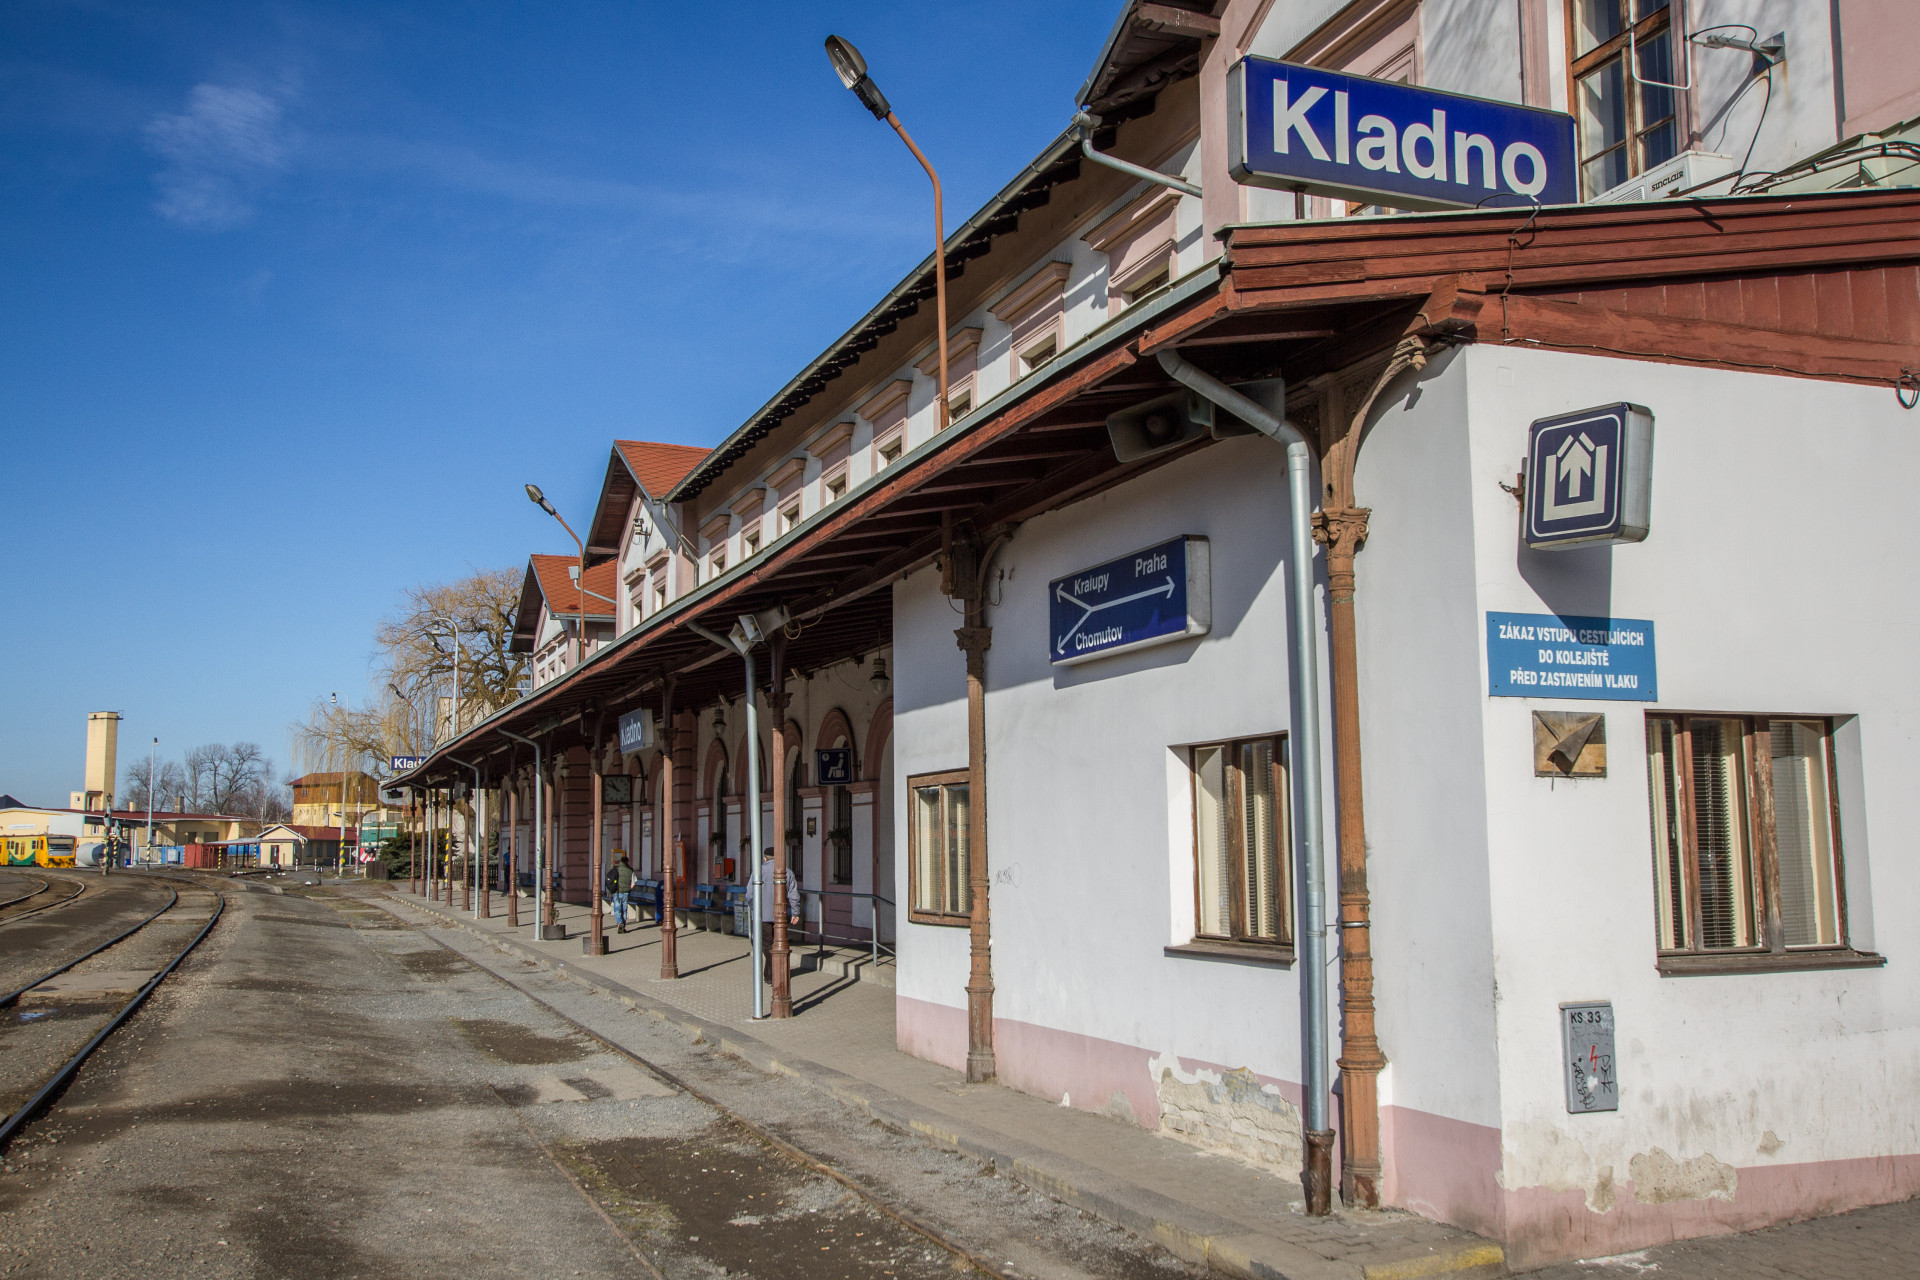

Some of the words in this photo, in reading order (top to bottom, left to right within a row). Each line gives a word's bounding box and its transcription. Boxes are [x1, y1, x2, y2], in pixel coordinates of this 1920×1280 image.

[1273, 78, 1548, 197] Kladno
[1135, 552, 1167, 578] Praha
[1073, 571, 1110, 596] Kralupy
[1075, 625, 1123, 651] Chomutov
[1499, 622, 1535, 641] ZÁKAZ
[1537, 627, 1577, 643] VSTUPU
[1579, 629, 1644, 646] CESTUJÍCÍCH
[1538, 649, 1553, 664] DO
[1555, 649, 1610, 667] KOLEJIŠTĚ
[1510, 667, 1537, 685] PŘED
[1540, 670, 1603, 688] ZASTAVENÍM
[1604, 674, 1638, 689] VLAKU
[1570, 1011, 1584, 1024] KS
[1587, 1011, 1602, 1024] 33
